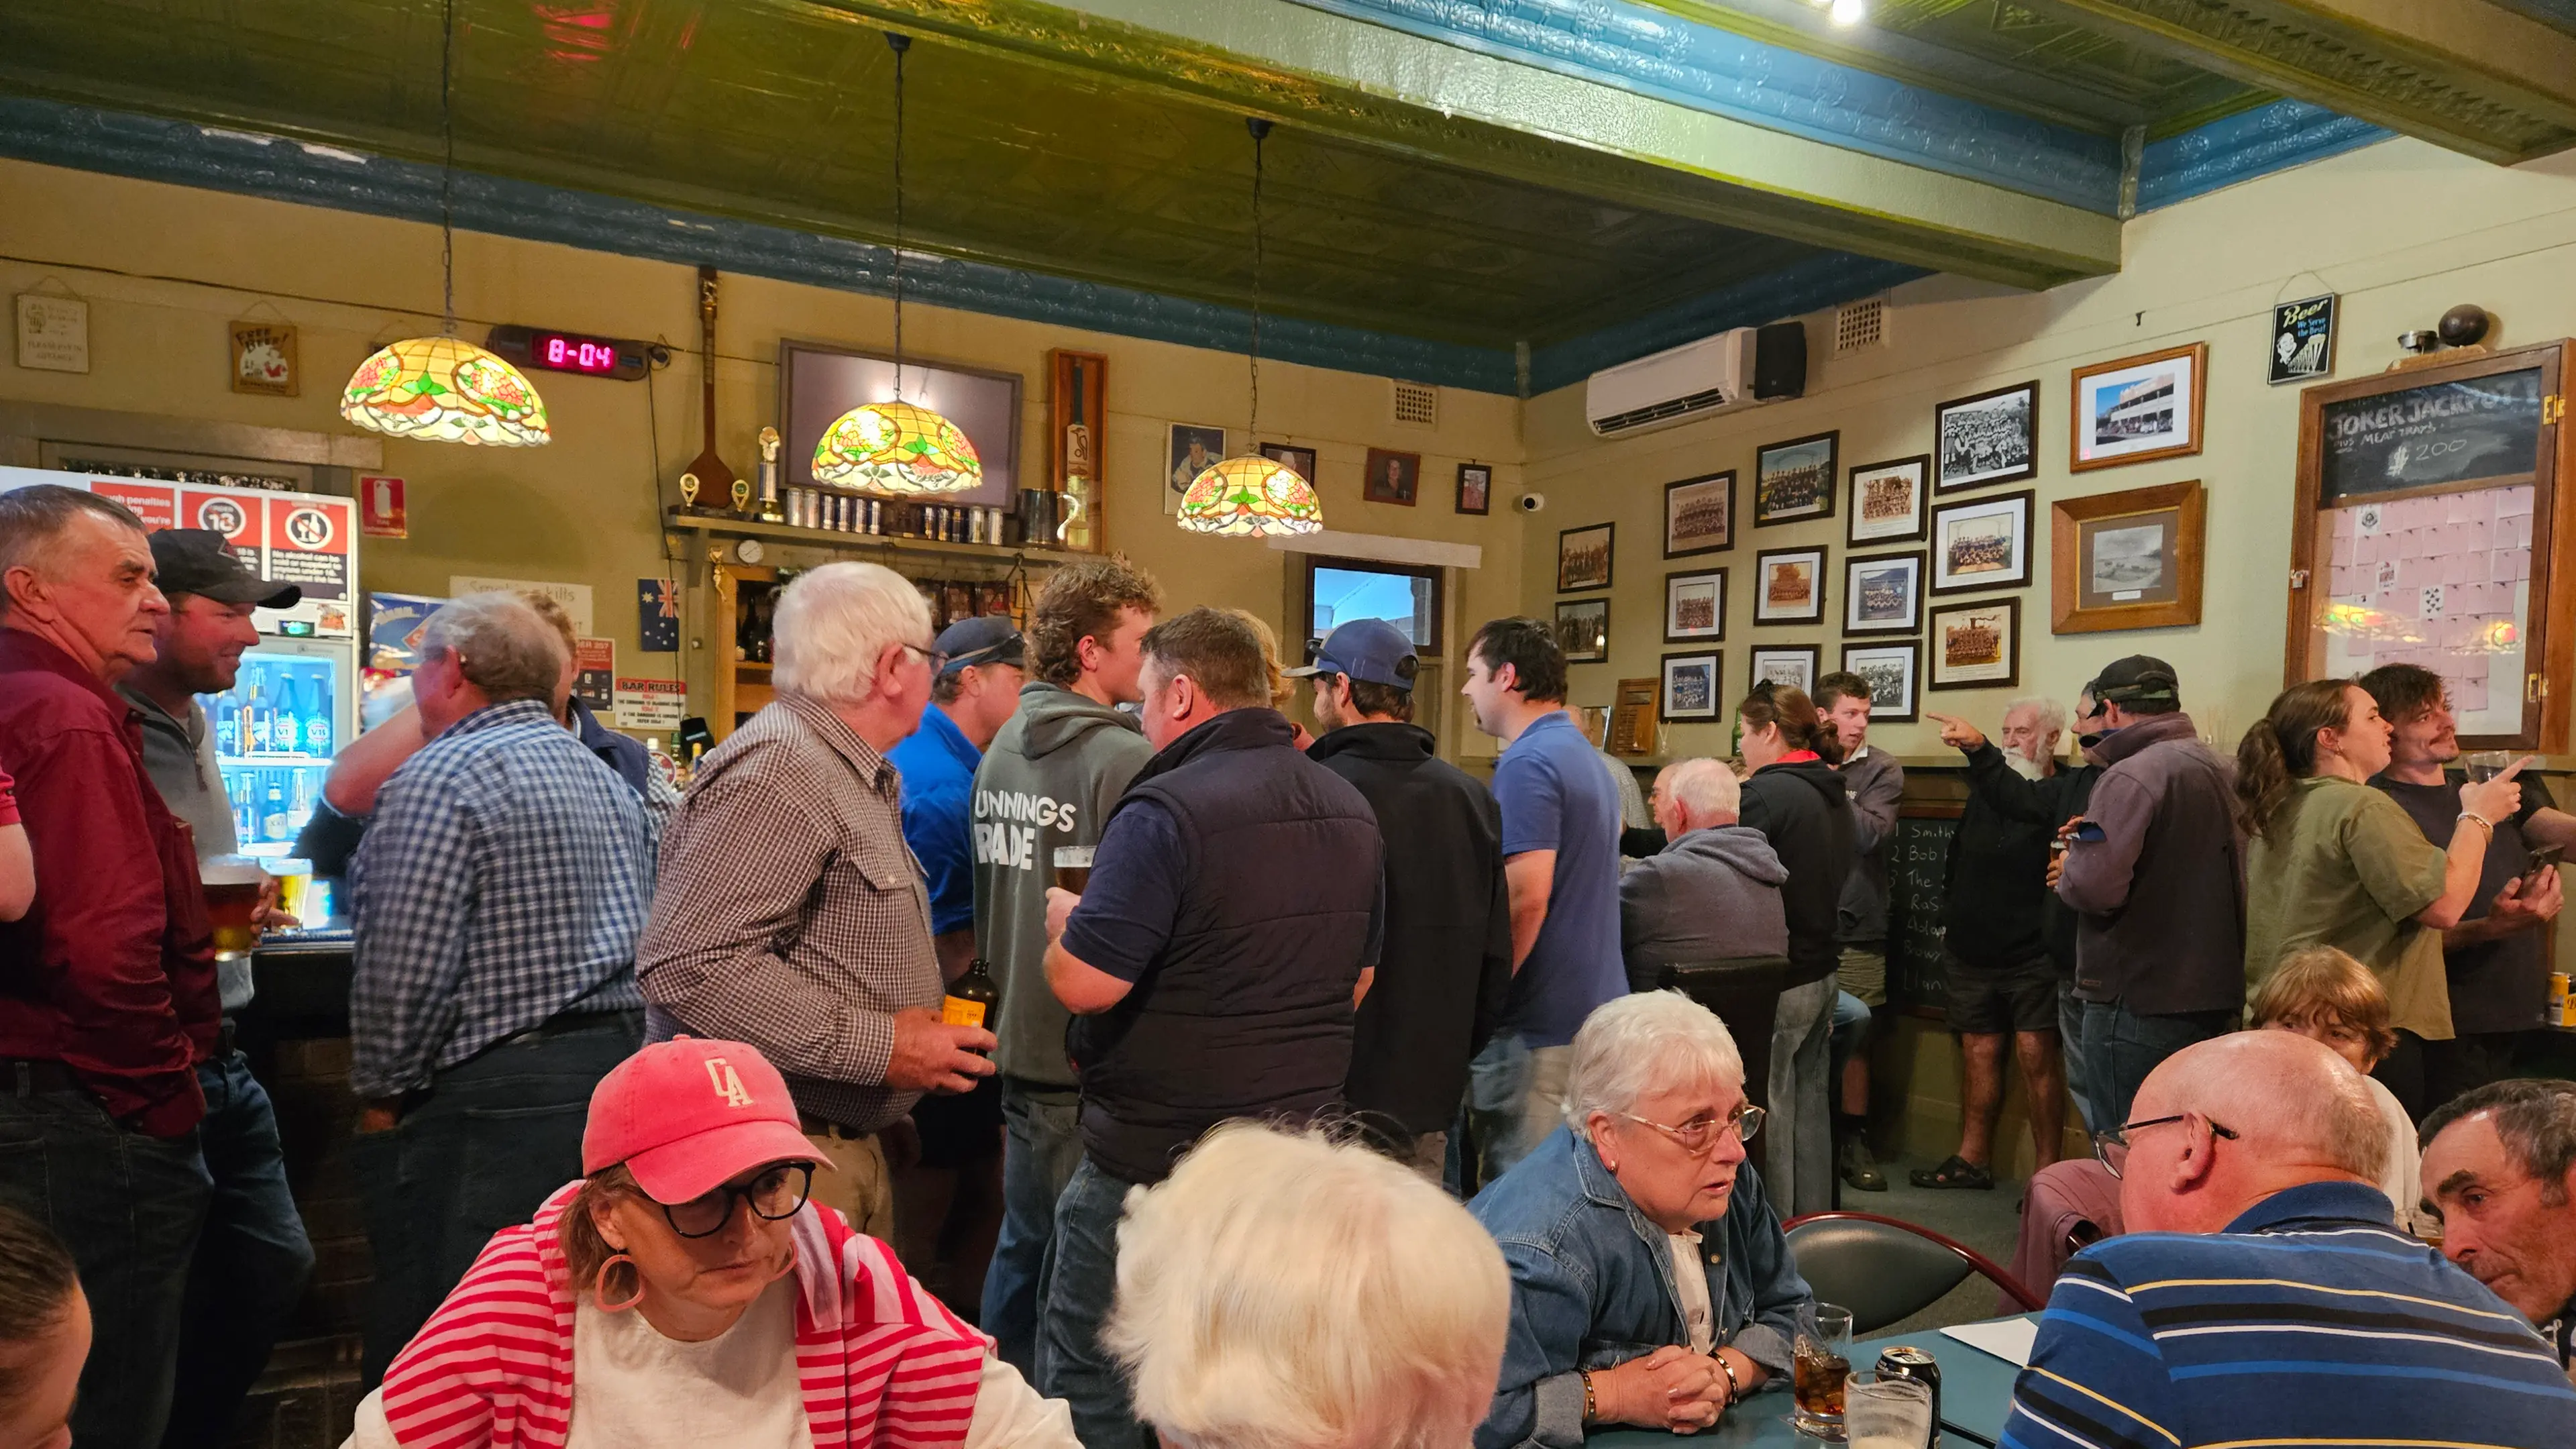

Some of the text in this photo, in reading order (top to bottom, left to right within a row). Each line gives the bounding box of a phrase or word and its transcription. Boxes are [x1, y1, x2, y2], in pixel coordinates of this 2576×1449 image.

[2283, 299, 2328, 328] Beer
[2329, 404, 2406, 438] JOKER
[622, 681, 680, 693] BAR RULES
[975, 790, 1076, 833] UNNINGS
[1911, 824, 1955, 839] Smith
[974, 822, 1035, 871] RADE
[1891, 845, 1900, 863] 2
[1909, 845, 1937, 861] Bob
[1907, 869, 1933, 888] The
